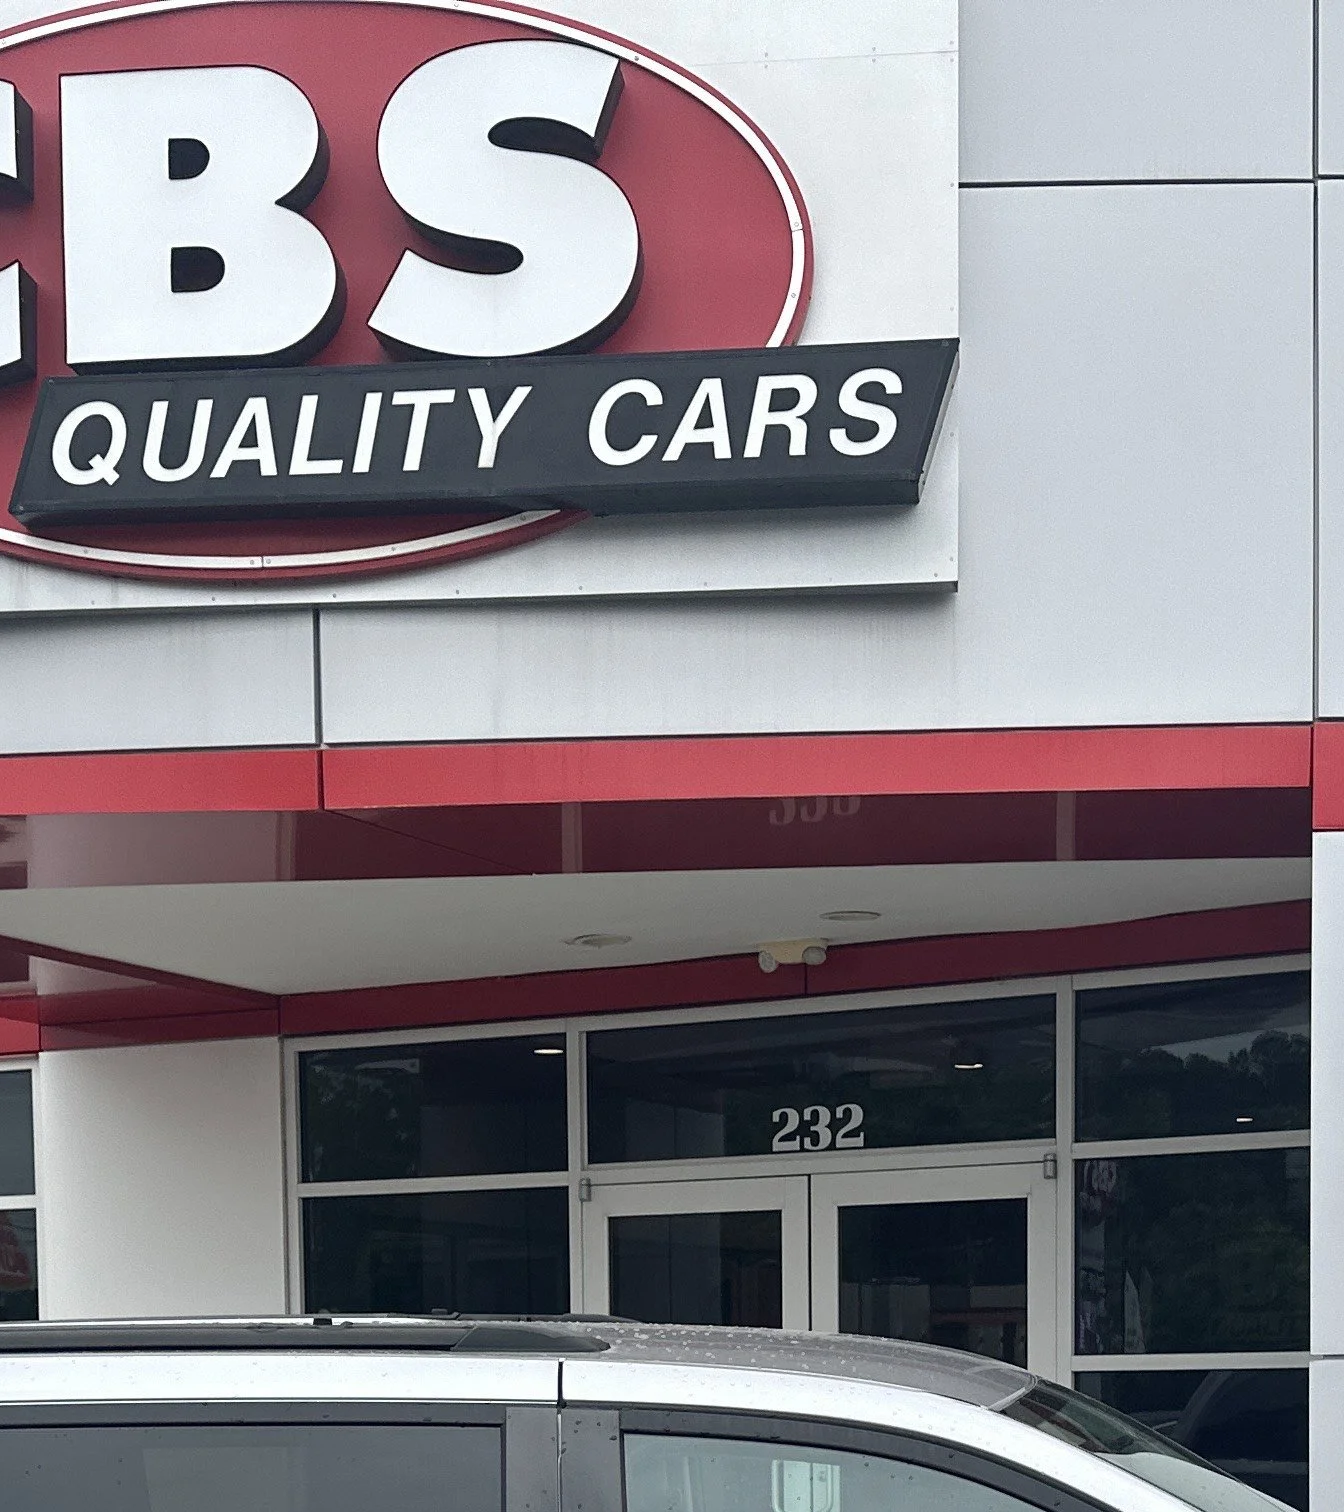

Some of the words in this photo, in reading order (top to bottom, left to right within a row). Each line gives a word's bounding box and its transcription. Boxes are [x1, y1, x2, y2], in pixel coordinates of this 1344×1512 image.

[51, 385, 530, 487] QUALITY
[588, 369, 904, 466] CARS
[772, 1103, 864, 1152] 232
